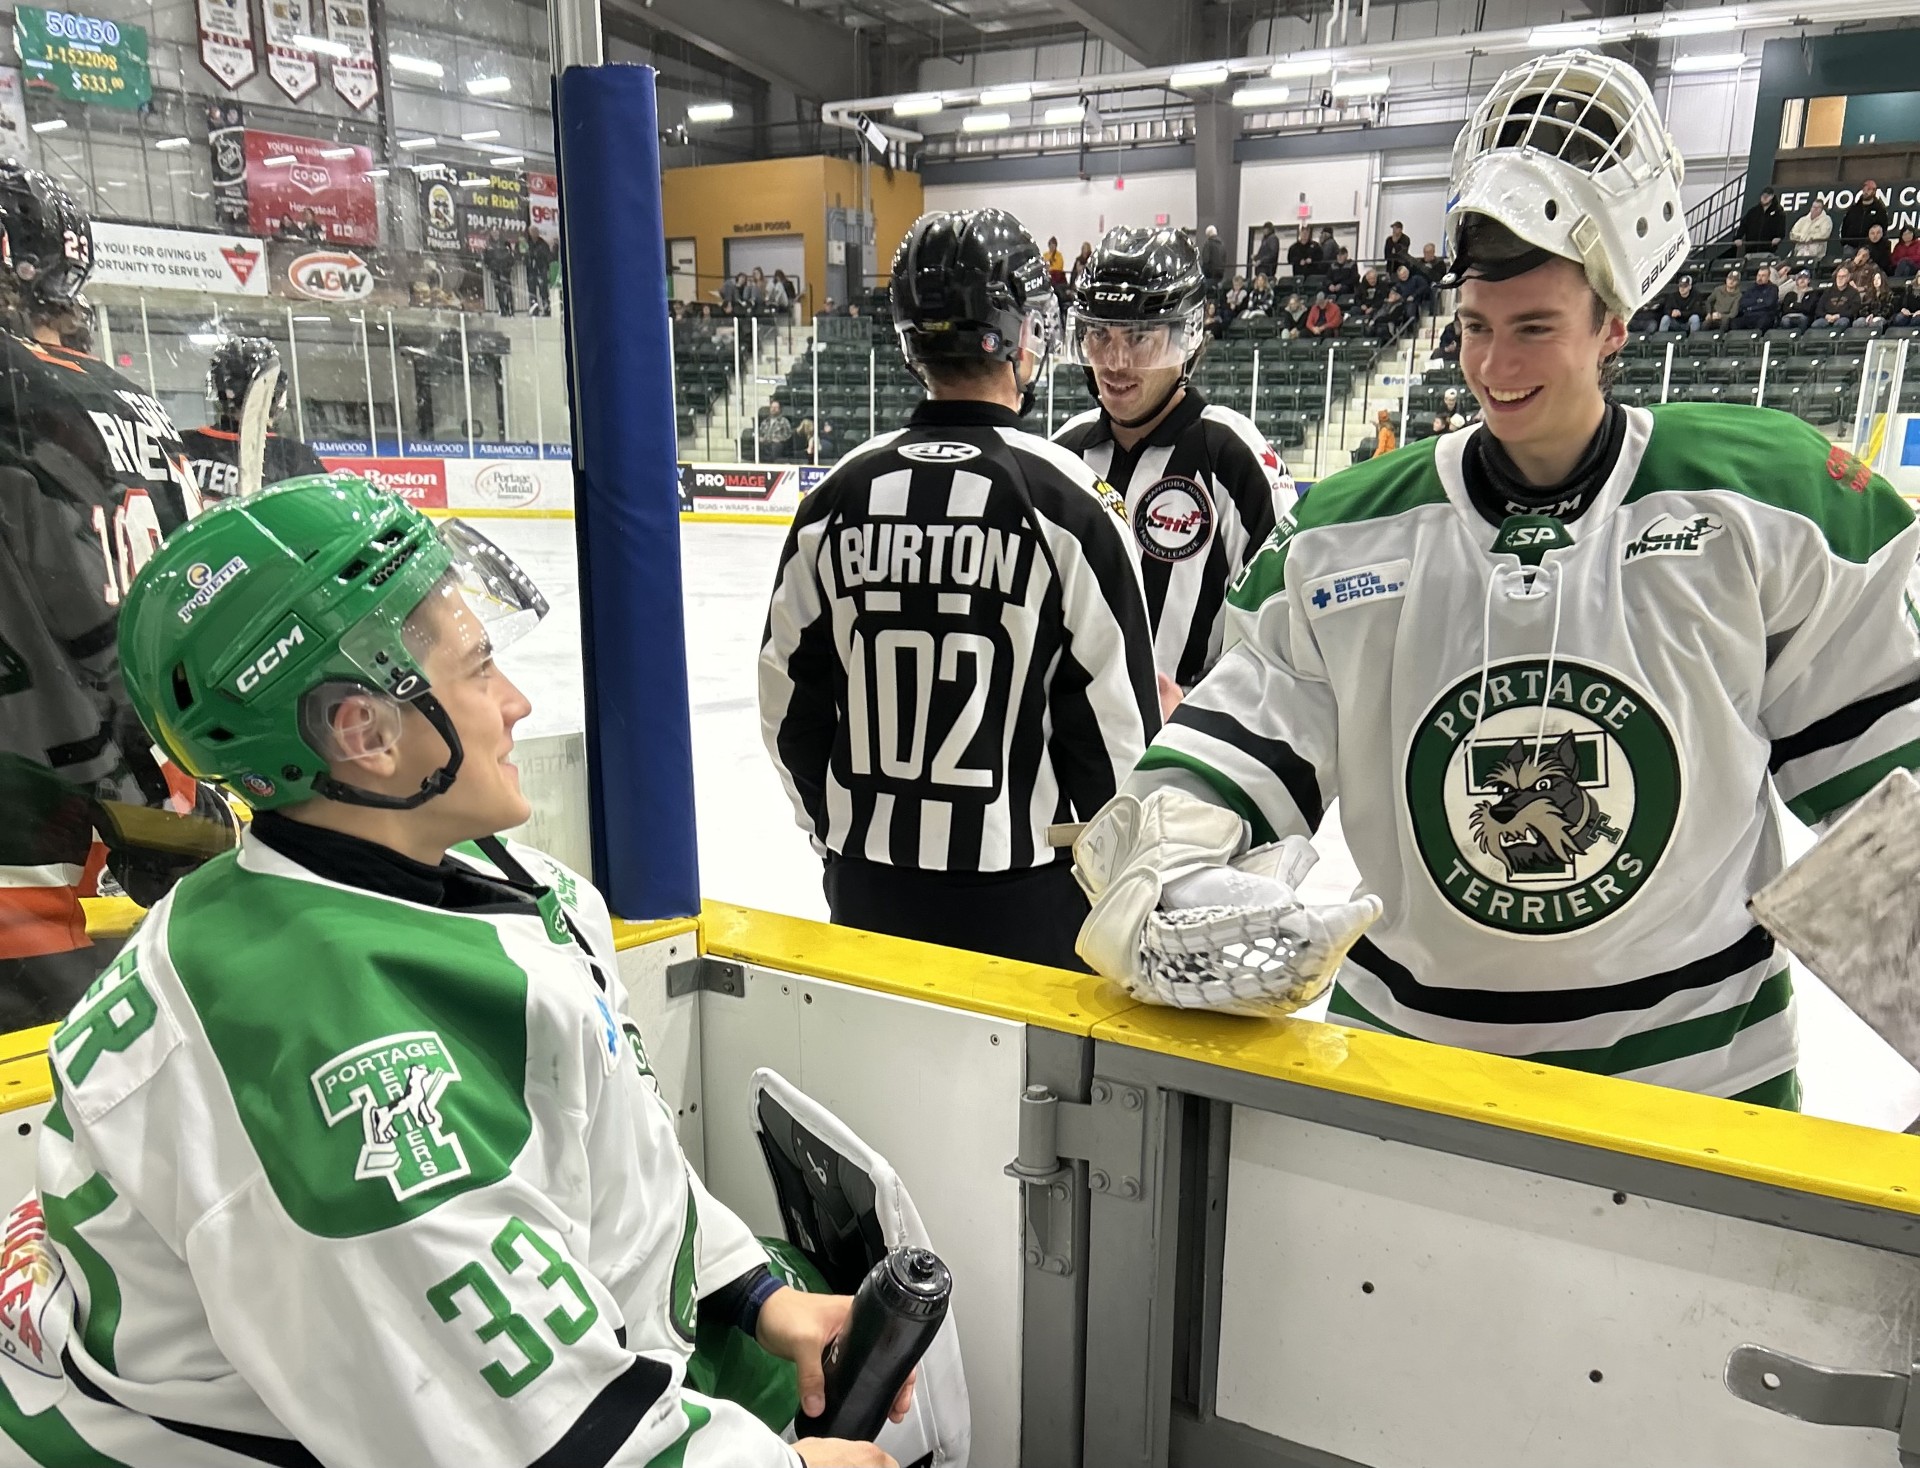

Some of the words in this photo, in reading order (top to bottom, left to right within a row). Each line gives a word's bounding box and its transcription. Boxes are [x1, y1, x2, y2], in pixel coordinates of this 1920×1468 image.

[294, 169, 327, 184] CO-OP
[490, 175, 521, 192] Place
[134, 246, 154, 256] FOR
[157, 247, 191, 261] GIVING
[194, 251, 206, 262] US
[153, 262, 166, 274] TO
[169, 264, 200, 277] SERVE
[203, 267, 222, 279] YOU
[306, 270, 367, 293] A&W
[1025, 276, 1043, 291] CCM
[1094, 291, 1135, 302] CCM
[312, 441, 367, 452] ARMWOOD
[409, 442, 464, 453] ARMWOOD
[480, 444, 534, 455] ARMWOOD
[364, 469, 438, 486] Boston
[493, 472, 530, 483] Portage
[498, 482, 533, 494] Mutual
[698, 503, 718, 511] SIGNS
[725, 504, 750, 513] WRAPS
[1505, 493, 1582, 517] CCM
[840, 523, 1021, 595] BURTON
[1335, 576, 1380, 593] BLUE
[1336, 583, 1399, 603] CROSS
[236, 625, 305, 693] CCM
[848, 629, 995, 788] 102
[1434, 670, 1638, 742] PORTAGE
[1444, 852, 1644, 924] TERRIERS
[324, 1041, 440, 1095] PORTAGE
[426, 1216, 599, 1398] 33
